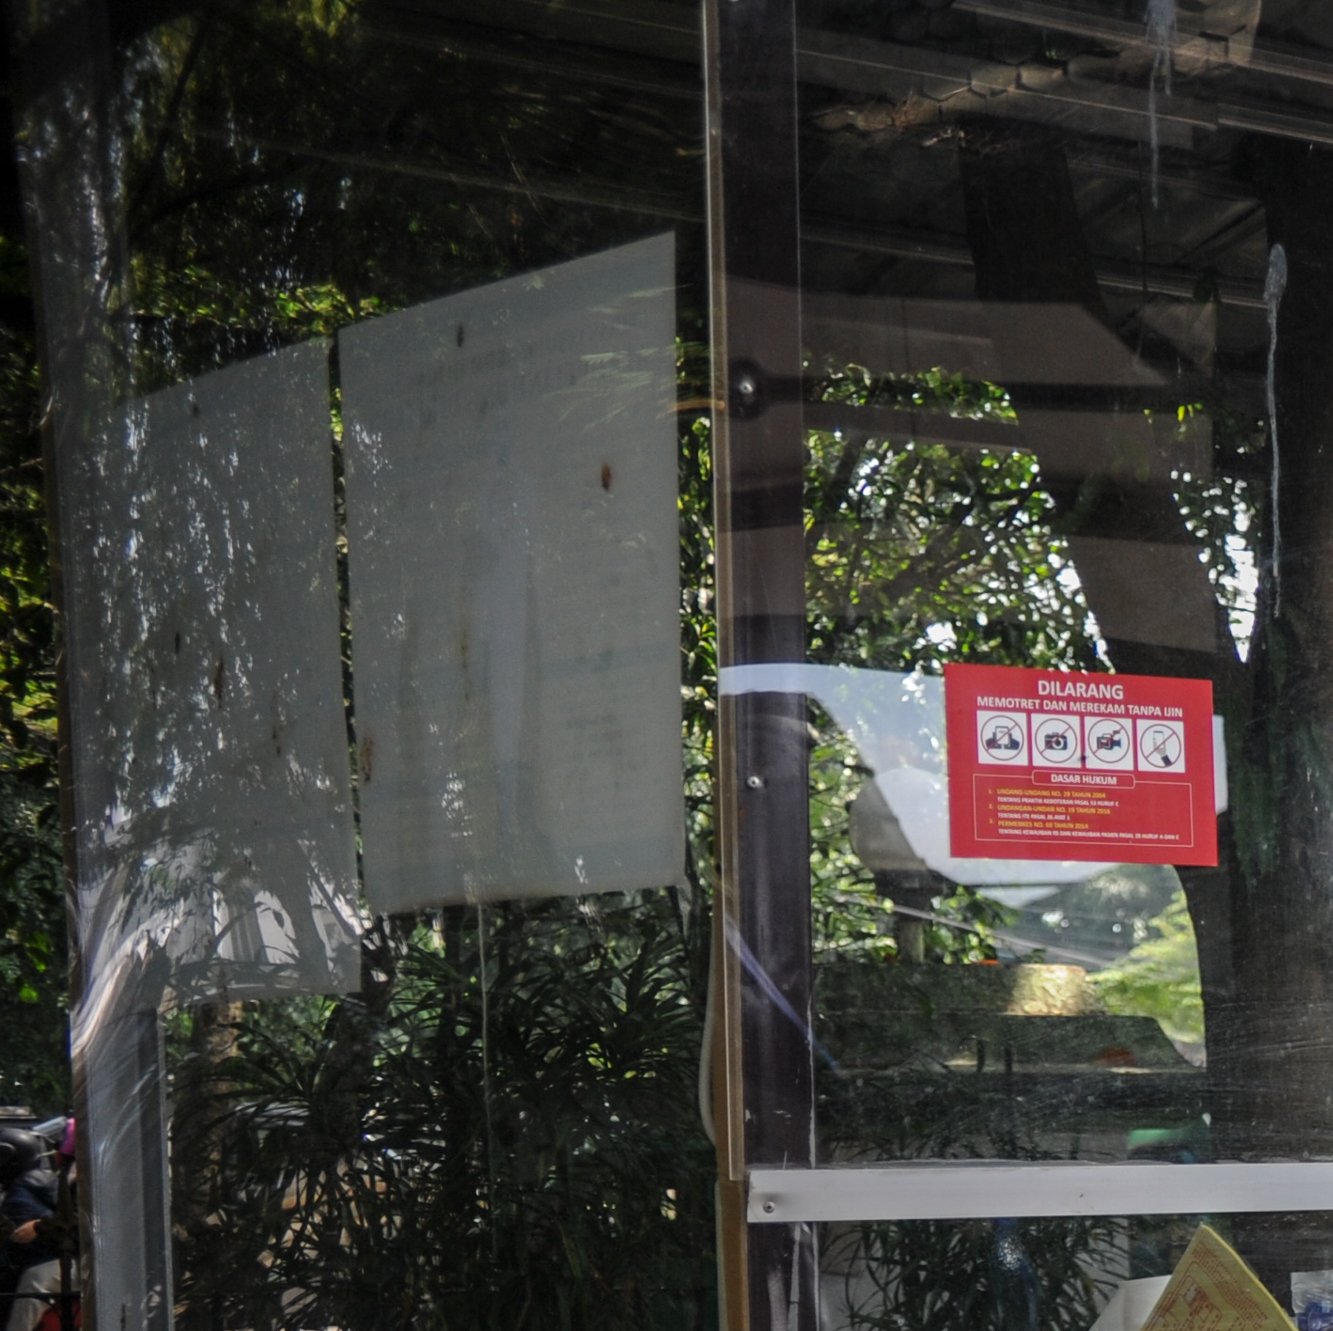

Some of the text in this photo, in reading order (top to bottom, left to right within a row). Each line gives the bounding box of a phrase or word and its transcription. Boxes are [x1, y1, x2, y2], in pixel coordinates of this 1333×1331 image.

[1038, 680, 1124, 700] DILARANG
[977, 696, 1183, 718] MEMOTRET DAN MEREKAM TANPA IJIN
[1050, 773, 1117, 785] DASAR HUKUM
